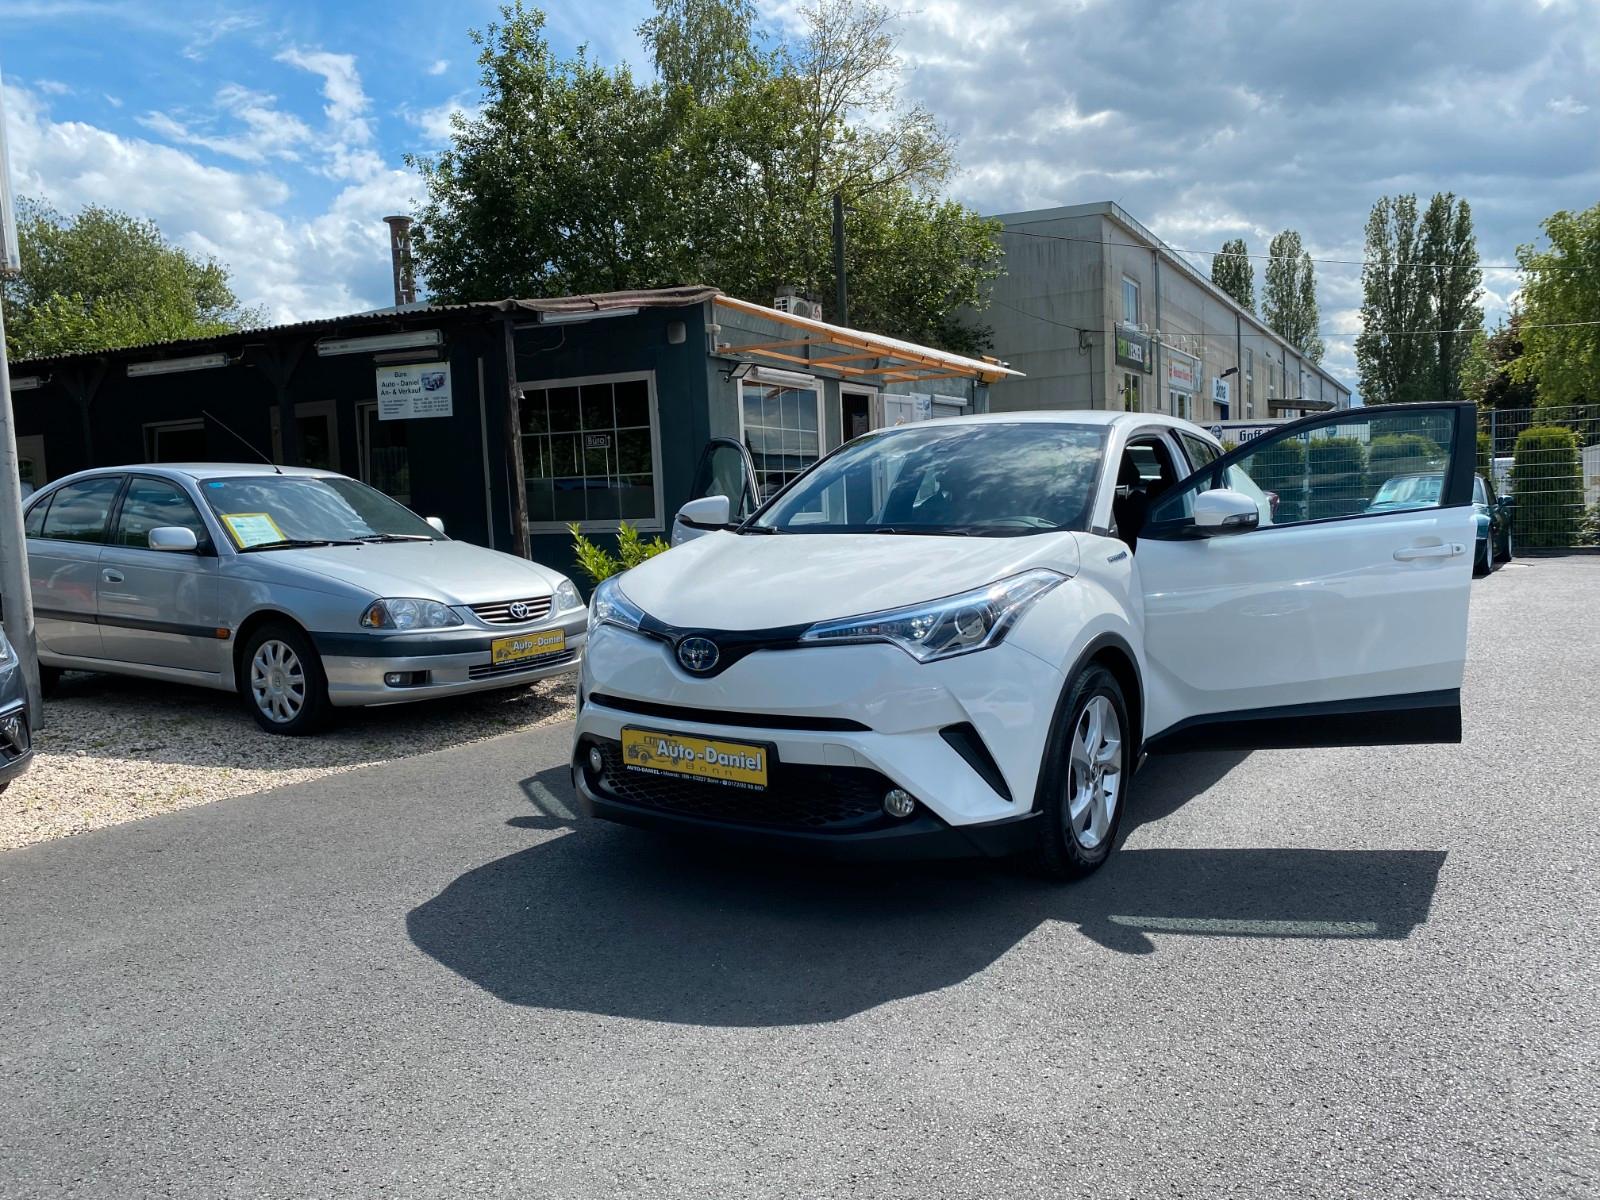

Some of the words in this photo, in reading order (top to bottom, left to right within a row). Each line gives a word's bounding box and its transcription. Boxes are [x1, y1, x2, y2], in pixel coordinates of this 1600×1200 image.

[400, 379, 419, 387] Daniel
[398, 387, 421, 395] Verkauf
[1239, 429, 1265, 441] Goff
[626, 765, 660, 775] AUTO-DANIEL
[685, 762, 733, 776] Bonn
